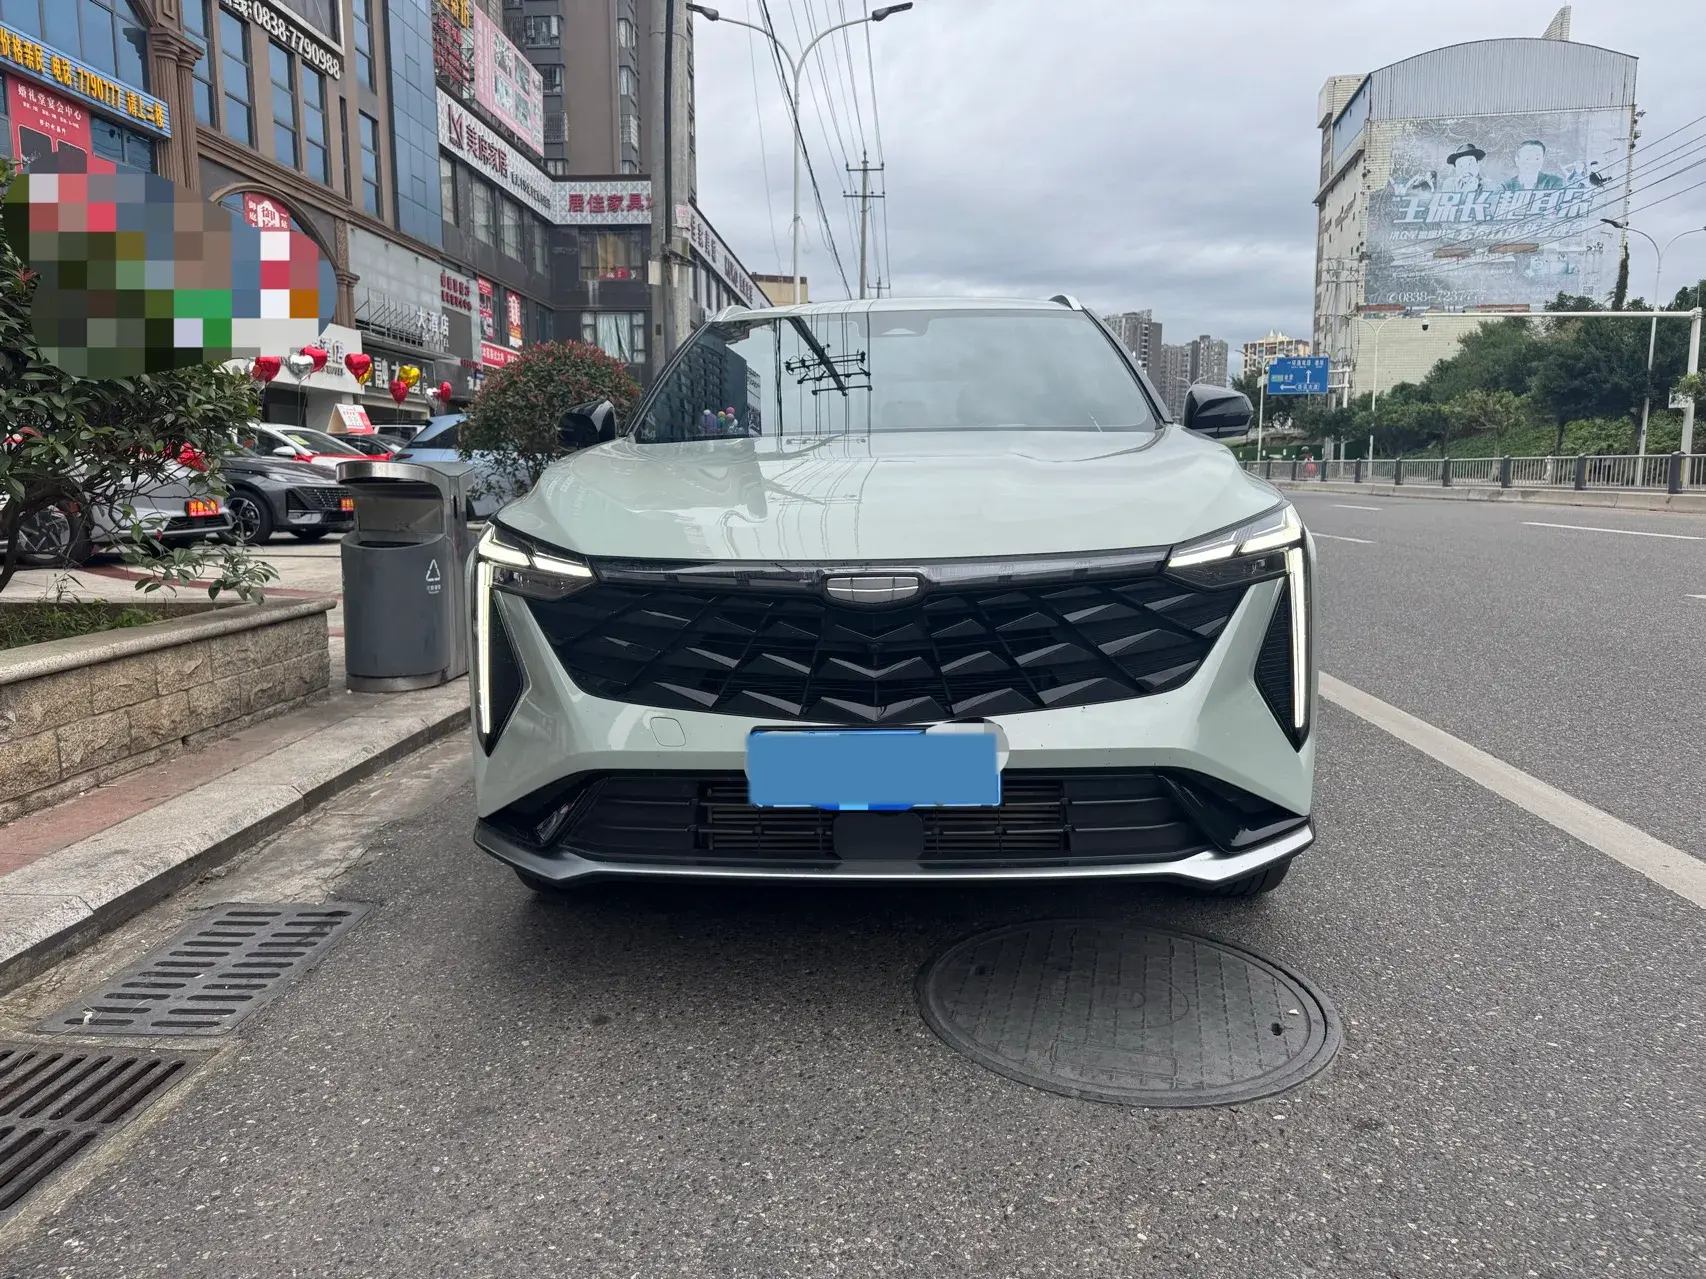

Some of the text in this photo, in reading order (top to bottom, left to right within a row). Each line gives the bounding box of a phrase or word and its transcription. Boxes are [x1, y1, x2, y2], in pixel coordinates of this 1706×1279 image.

[0, 27, 44, 73] 价格亲民
[125, 90, 164, 129] 请上二楼
[18, 84, 82, 120] 婚礼堂宴会中心
[416, 305, 449, 336] 大酒店
